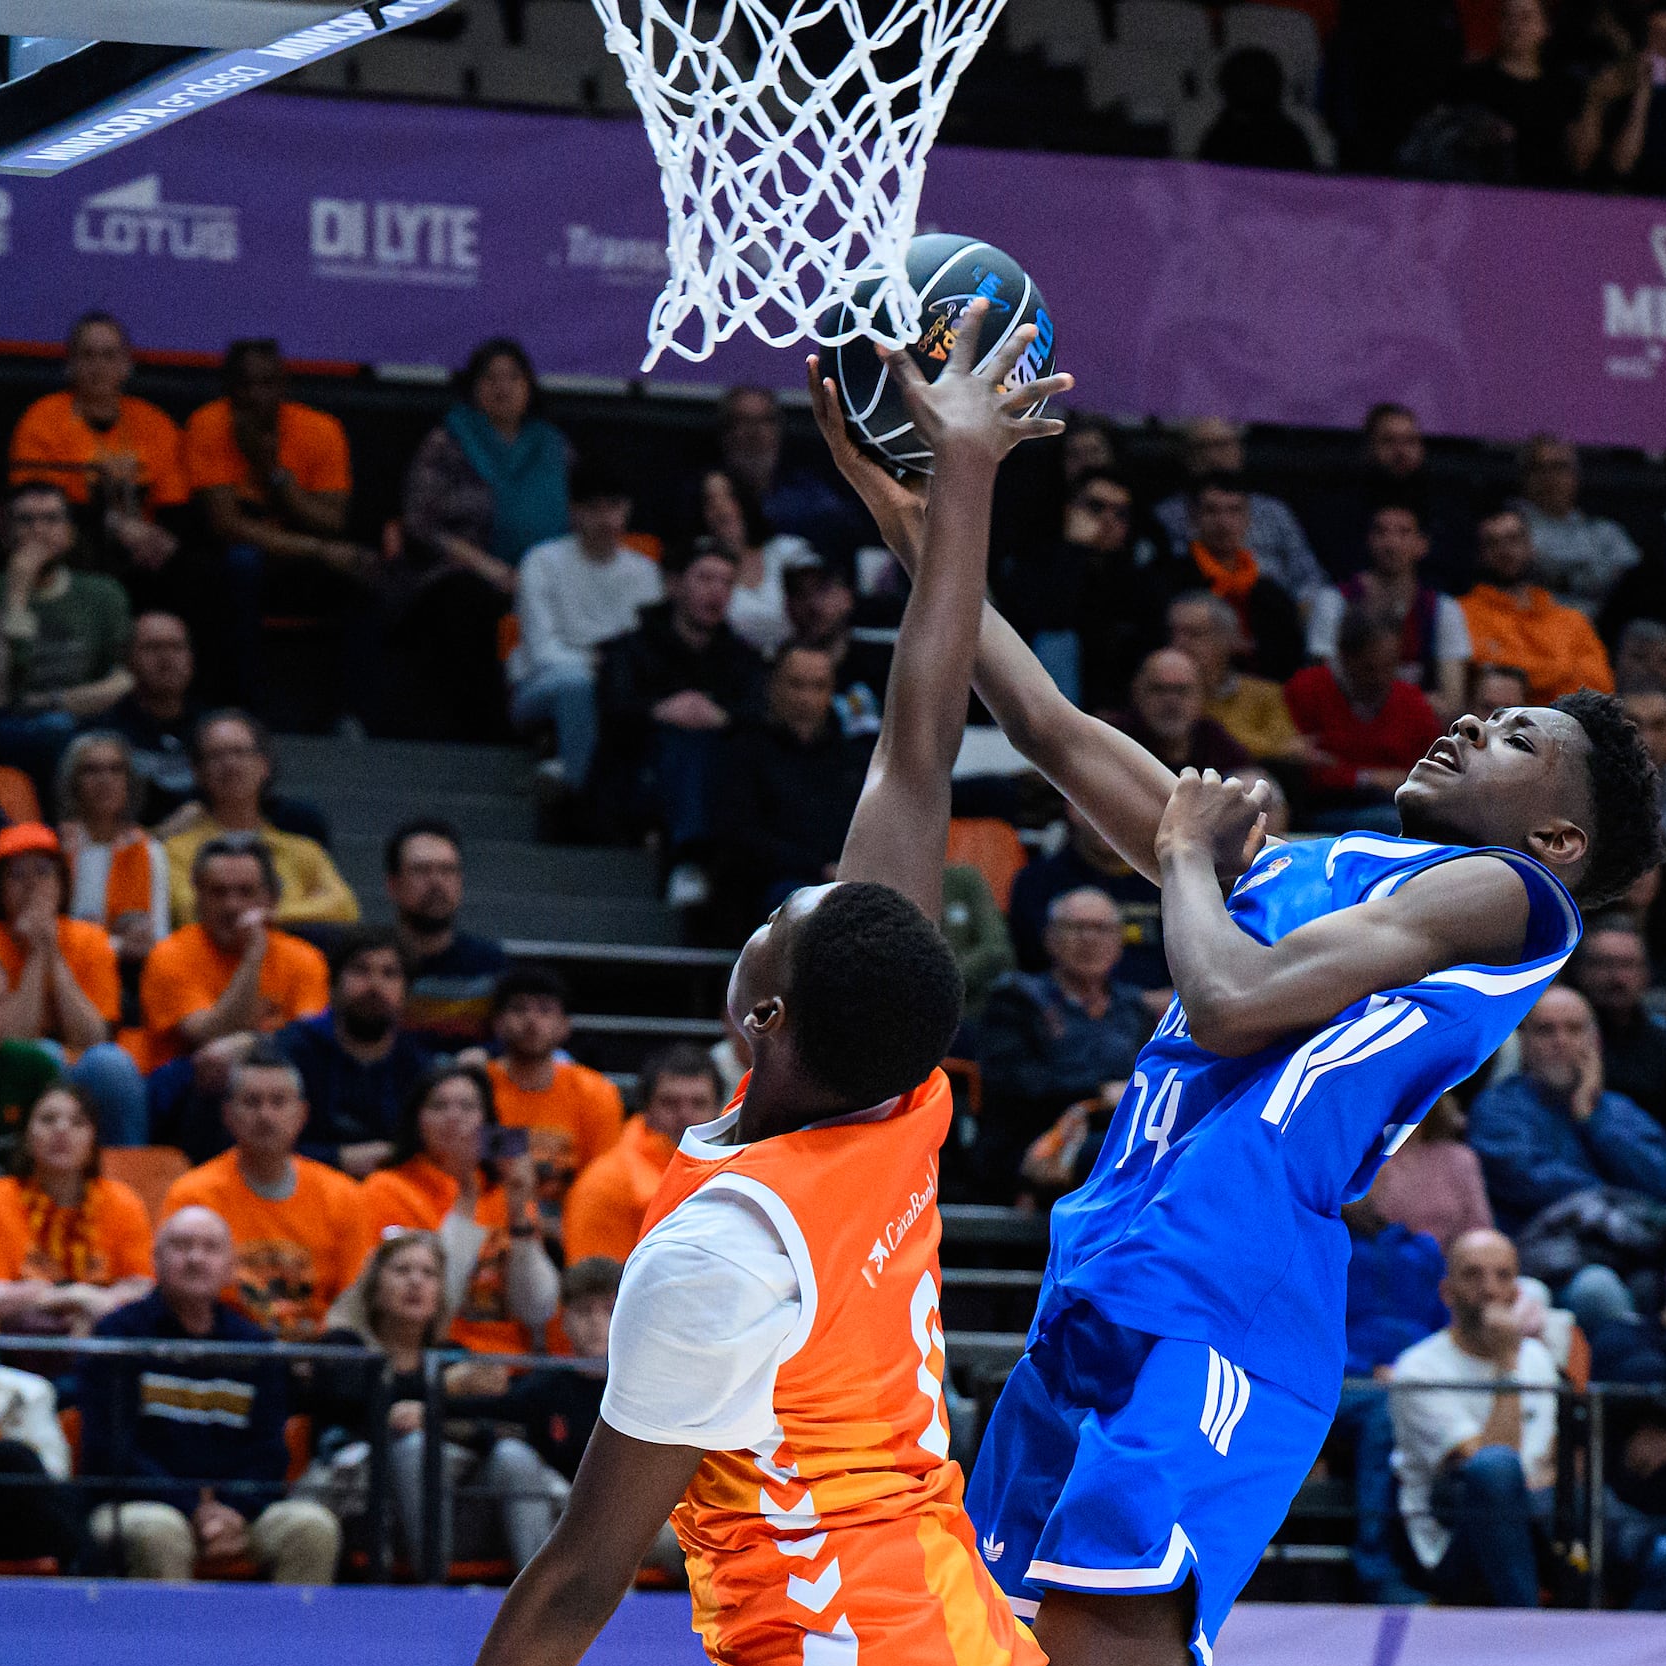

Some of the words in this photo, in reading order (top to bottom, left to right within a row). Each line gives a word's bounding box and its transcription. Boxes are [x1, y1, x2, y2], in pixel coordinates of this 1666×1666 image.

[27, 107, 174, 161] MINICOPA
[156, 64, 272, 110] endesa
[73, 210, 239, 260] LOTUS
